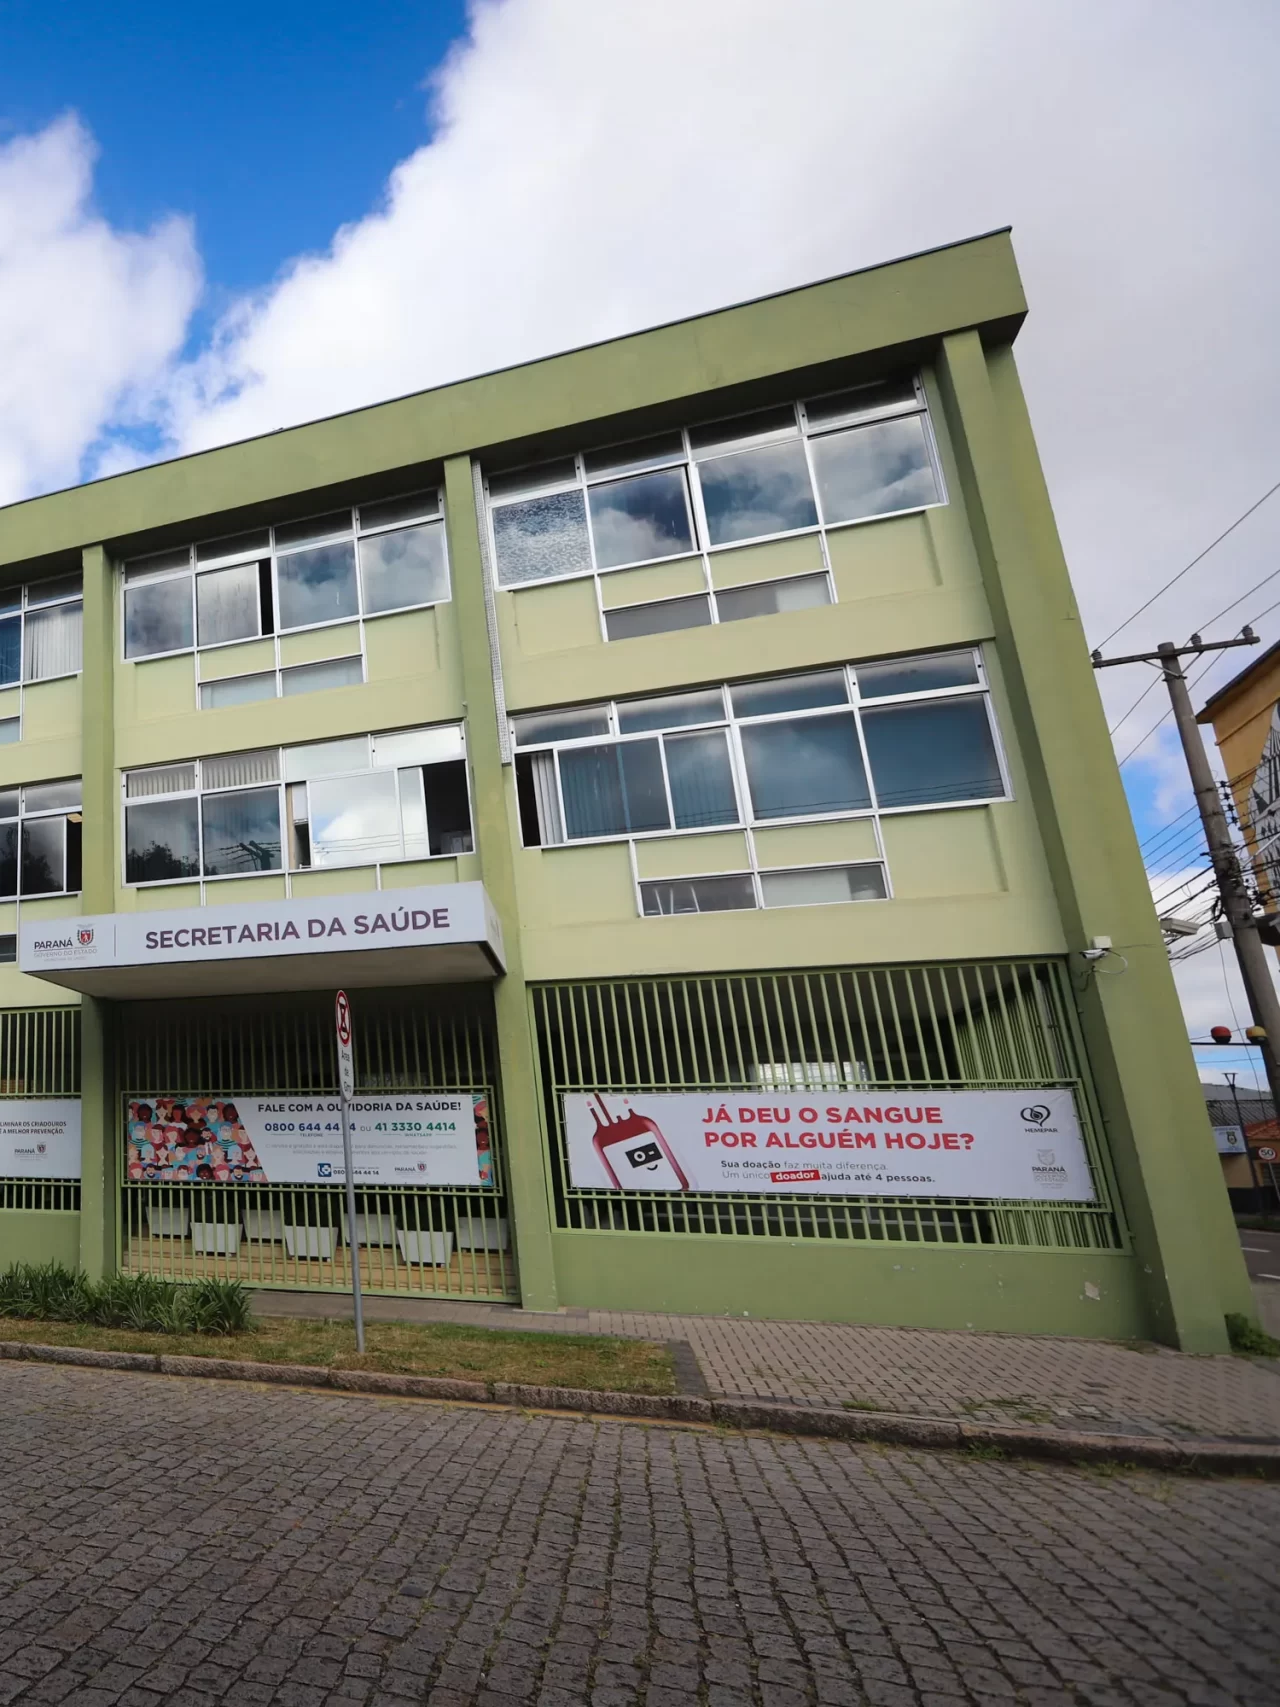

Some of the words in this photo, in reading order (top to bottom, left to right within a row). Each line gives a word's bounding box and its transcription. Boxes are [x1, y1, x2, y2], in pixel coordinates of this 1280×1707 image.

[146, 920, 300, 950] SECRETARIA
[307, 916, 346, 939] DA
[354, 906, 450, 935] SAÚDE
[34, 937, 73, 949] PARANÁ
[34, 950, 62, 958] GOVERNO
[74, 948, 97, 956] ESTADO
[258, 1104, 285, 1112] FALE
[288, 1104, 313, 1112] COM
[316, 1103, 324, 1112] A
[396, 1102, 413, 1111] DA
[416, 1100, 461, 1111] SAÚDE!
[702, 1104, 732, 1124] JÁ
[738, 1107, 791, 1124] DEU
[798, 1107, 818, 1124] O
[826, 1107, 943, 1124] SANGUE
[265, 1123, 295, 1131] 0800
[298, 1123, 321, 1131] 644
[375, 1122, 387, 1131] 41
[391, 1122, 422, 1131] 3330
[426, 1122, 456, 1131] 4414
[704, 1132, 758, 1148] POR
[765, 1129, 877, 1149] ALGUÉM
[884, 1132, 975, 1150] HOJE?
[721, 1160, 739, 1168] Sua
[742, 1160, 781, 1169] doação
[784, 1161, 799, 1169] faz
[803, 1161, 832, 1169] muita
[836, 1161, 888, 1171] diferença.
[742, 1170, 770, 1179] único
[776, 1171, 815, 1181] doador
[821, 1172, 851, 1182] ajuda
[854, 1173, 872, 1181] até
[875, 1173, 883, 1181] 4
[886, 1174, 936, 1183] pessoas.
